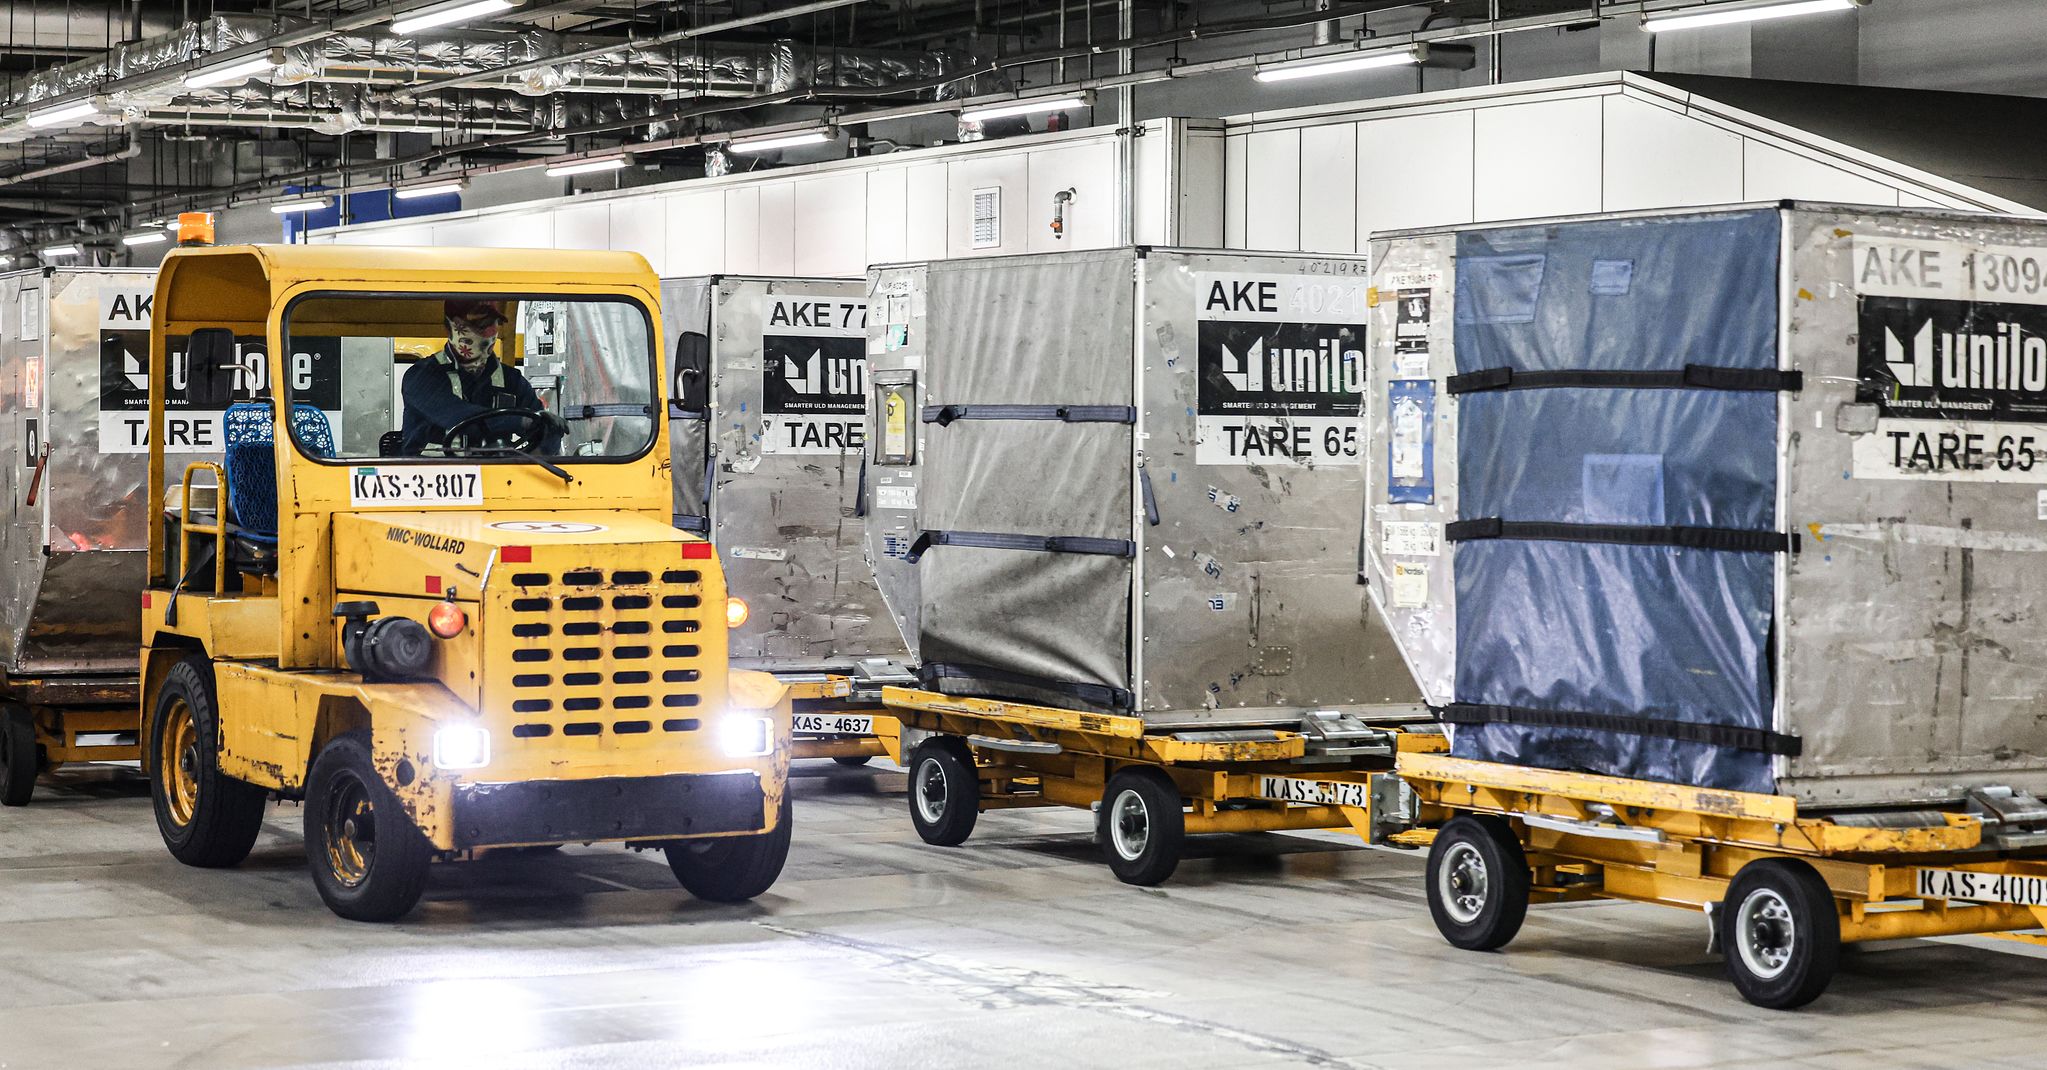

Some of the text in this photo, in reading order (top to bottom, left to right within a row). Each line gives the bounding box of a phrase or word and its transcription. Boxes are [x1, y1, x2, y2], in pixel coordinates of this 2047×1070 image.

[1861, 246, 1943, 288] AKE
[108, 294, 153, 321] AK
[1205, 280, 1278, 313] AKE
[770, 301, 831, 328] AKE
[784, 422, 864, 448] TARE
[1222, 426, 1358, 457] TARE 65
[1886, 431, 2035, 472] TARE 65
[354, 473, 476, 498] KAS-3-807
[387, 526, 465, 555] NMC-WOLLARD
[792, 716, 822, 731] KAS
[834, 718, 870, 732] 4637
[1921, 870, 2047, 905] KAS-400
